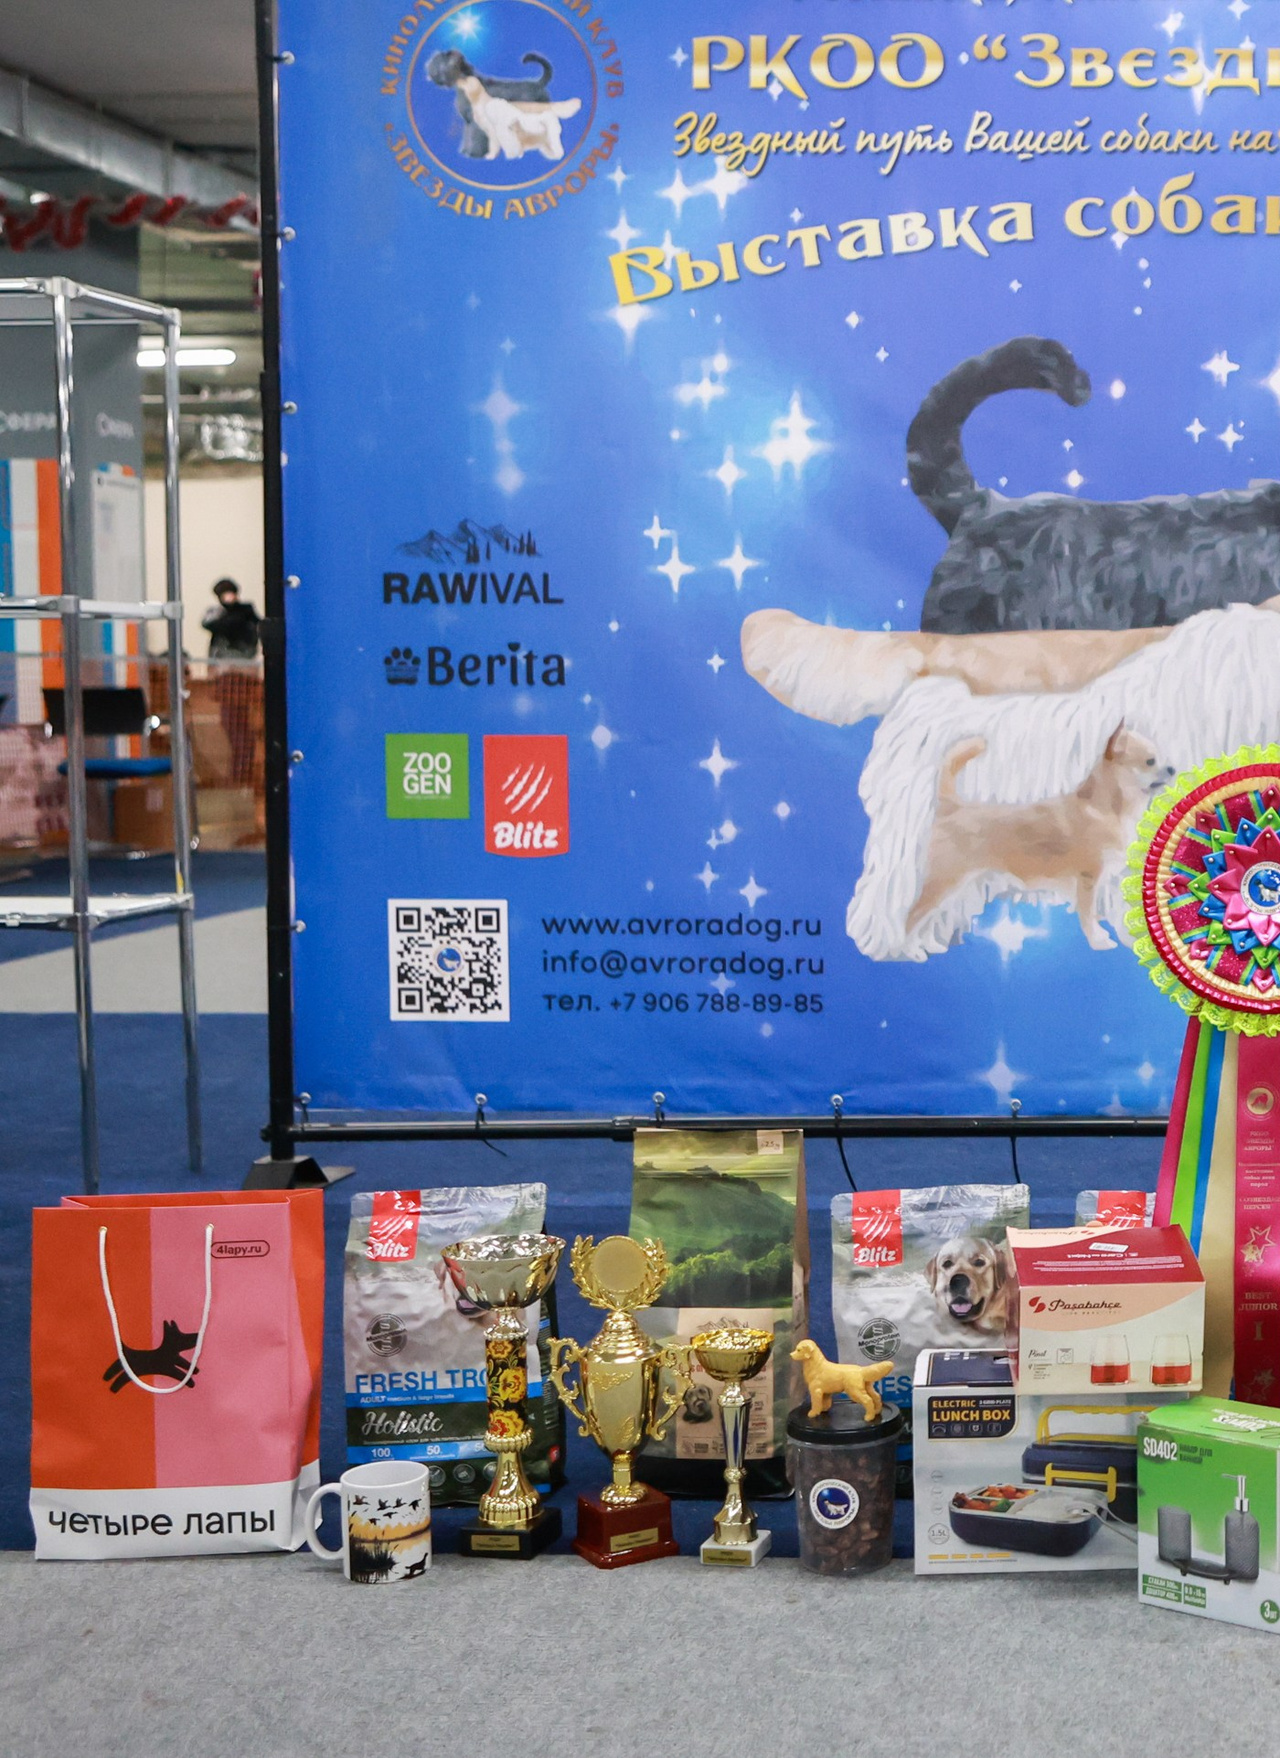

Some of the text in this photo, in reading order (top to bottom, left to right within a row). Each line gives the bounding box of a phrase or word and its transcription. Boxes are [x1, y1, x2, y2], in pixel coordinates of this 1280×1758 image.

[673, 111, 845, 176] Звездный
[856, 124, 953, 175] путь
[965, 111, 1091, 162] Вашей
[1100, 112, 1219, 154] собаки
[608, 201, 1034, 305] Выставка
[383, 572, 564, 604] RAWIVAL
[427, 642, 566, 686] Berita
[403, 752, 451, 774] ZOO
[403, 774, 451, 795] GEN
[493, 821, 559, 849] Blitz
[542, 912, 821, 942] www.avroradog.ru
[542, 950, 824, 979] info@avroradog.ru
[542, 993, 824, 1013] тел. +7 906 788-89-85
[216, 1243, 263, 1256] 4lapy.ru
[372, 1239, 410, 1259] Blitz
[857, 1246, 897, 1263] Blitz
[1239, 1302, 1278, 1311] JUNIOR
[355, 1370, 437, 1393] FRESH
[932, 1400, 977, 1408] ELECTRIC
[932, 1409, 1011, 1422] LUNCH BOX
[361, 1410, 444, 1436] Holistic
[371, 1447, 391, 1458] 100
[426, 1445, 441, 1455] 50
[1143, 1436, 1178, 1461] SD402
[48, 1508, 276, 1537] четыре лапы
